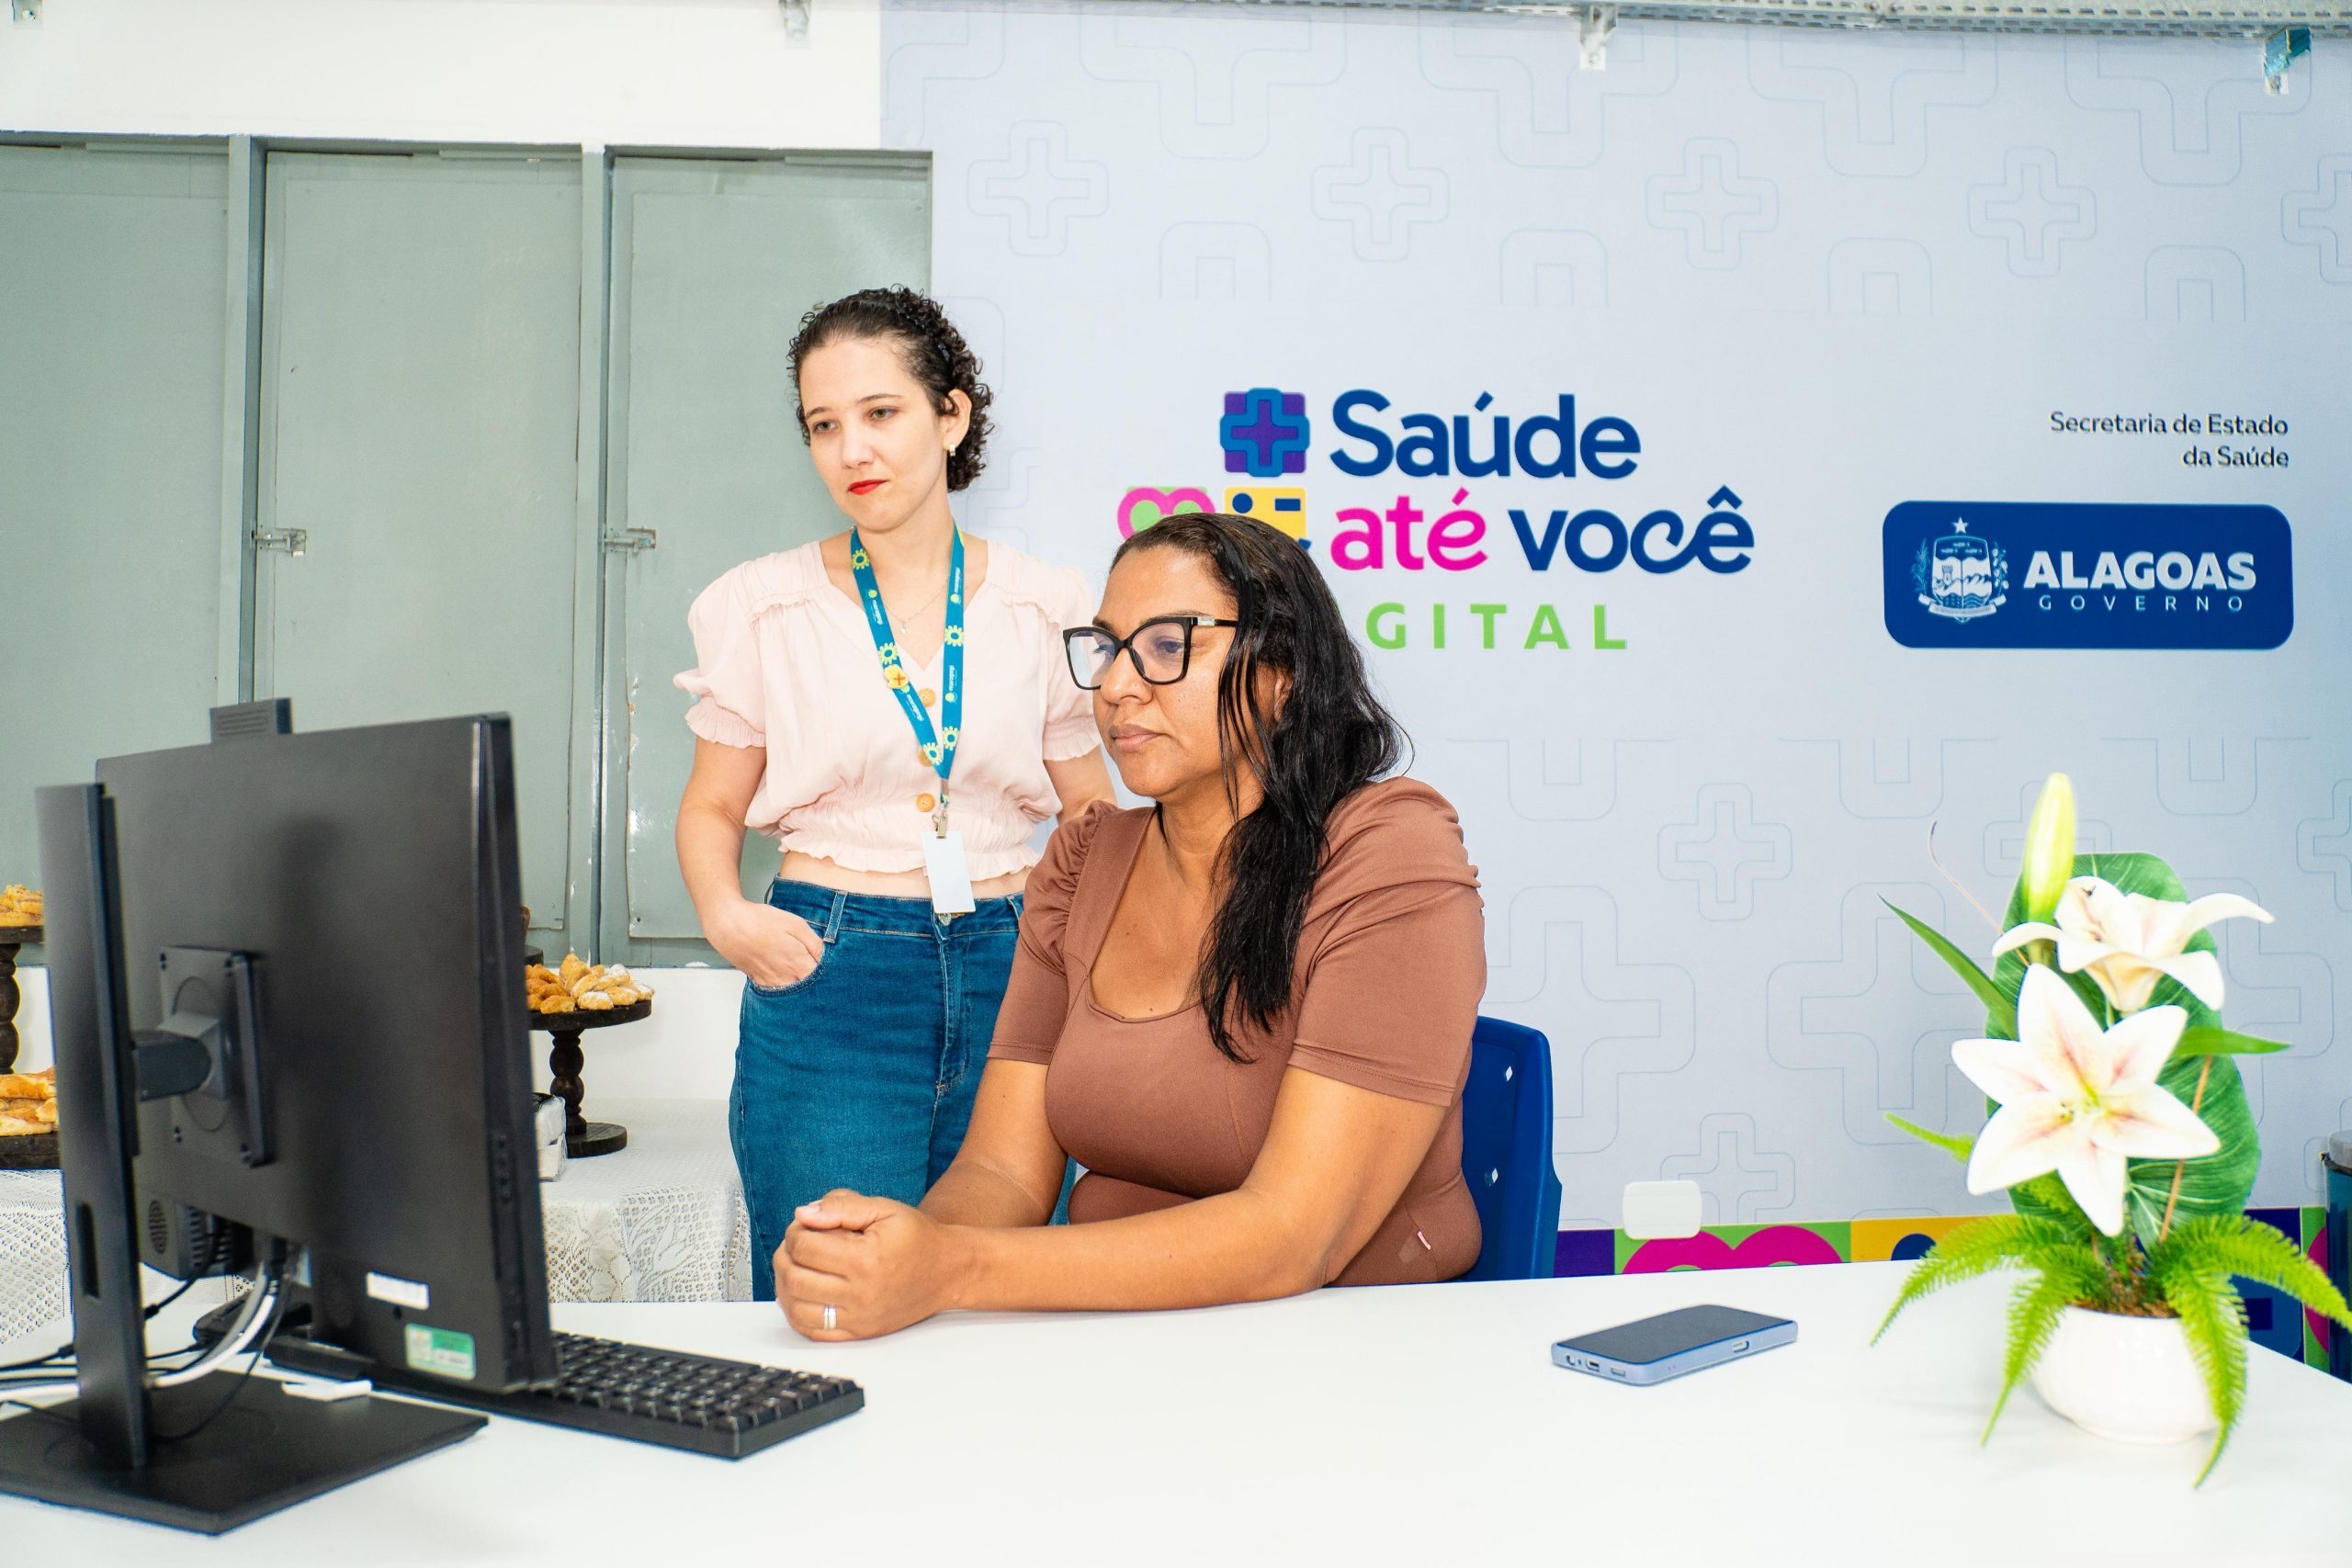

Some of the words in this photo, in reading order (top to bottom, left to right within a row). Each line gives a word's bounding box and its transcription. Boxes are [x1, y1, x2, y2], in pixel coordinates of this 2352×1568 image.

[1330, 389, 1641, 479] Saúde
[2050, 412, 2168, 434] Secretaria
[2173, 412, 2202, 435] de
[2208, 412, 2290, 437] Estado
[2182, 445, 2213, 468] da
[2217, 445, 2290, 469] Saúde
[1330, 488, 1487, 570] até
[1507, 485, 1754, 574] você
[2024, 552, 2256, 590] ALAGOAS
[2039, 595, 2243, 611] GOVERNO
[1366, 603, 1625, 649] GITAL
